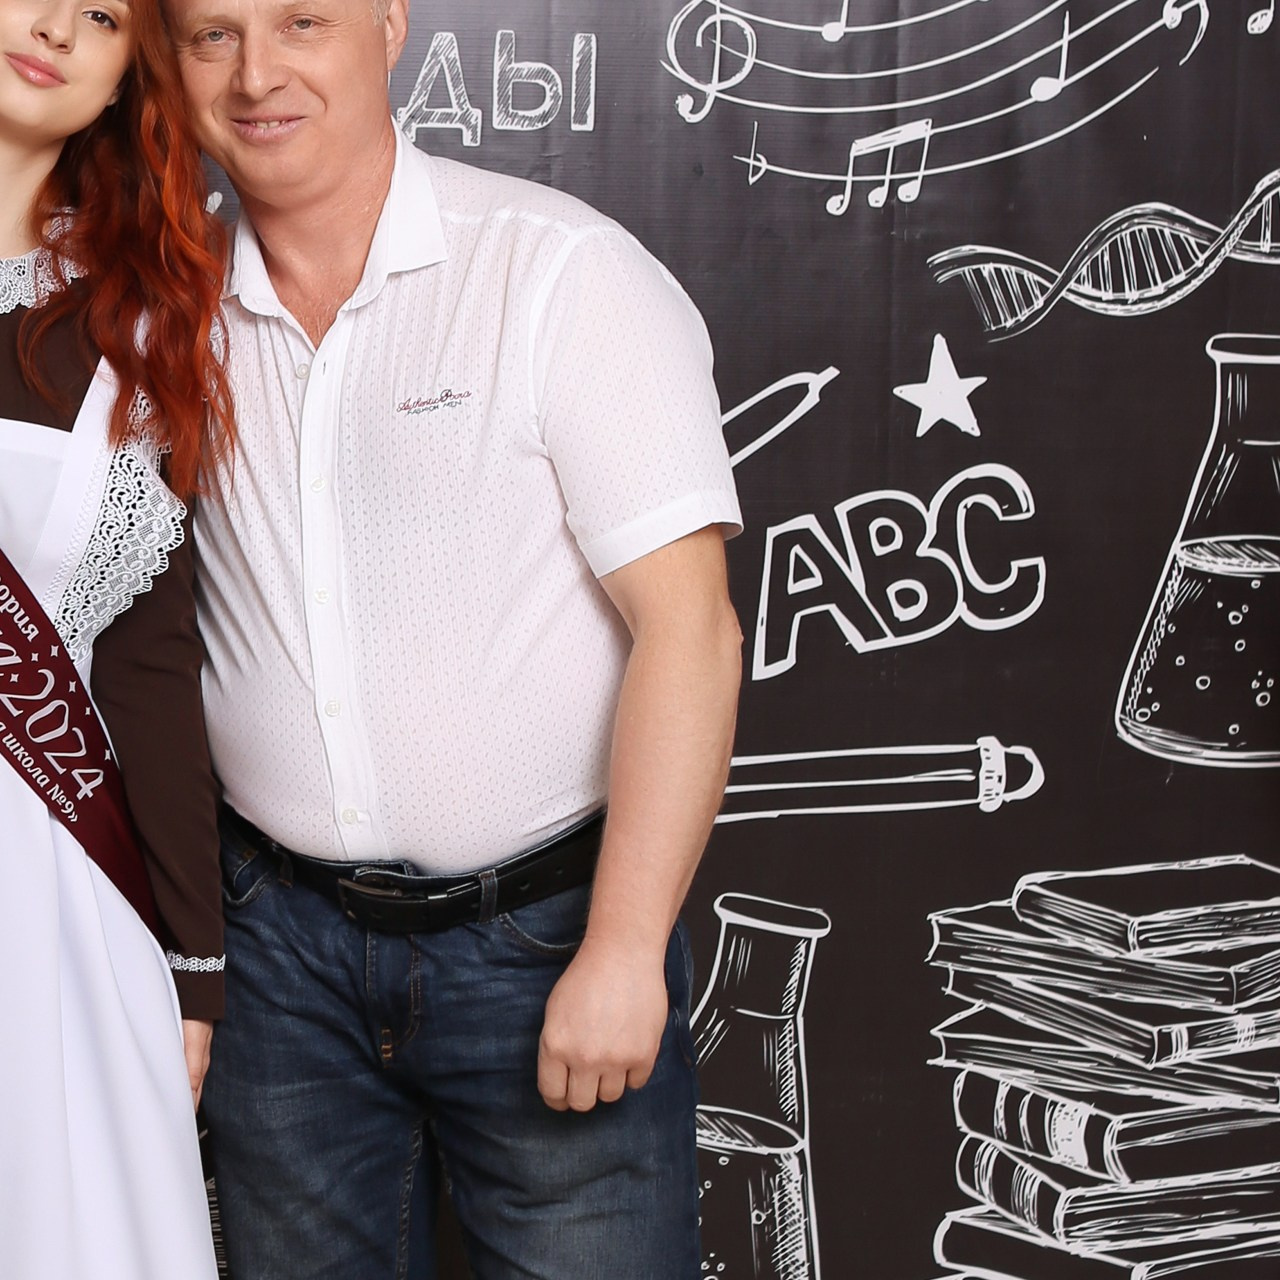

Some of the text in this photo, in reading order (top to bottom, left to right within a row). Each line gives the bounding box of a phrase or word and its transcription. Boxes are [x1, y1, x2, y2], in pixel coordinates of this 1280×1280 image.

[396, 30, 597, 147] ДЫ
[751, 463, 1046, 681] ABC
[2, 731, 51, 789] школа
[45, 783, 79, 823] №9»
